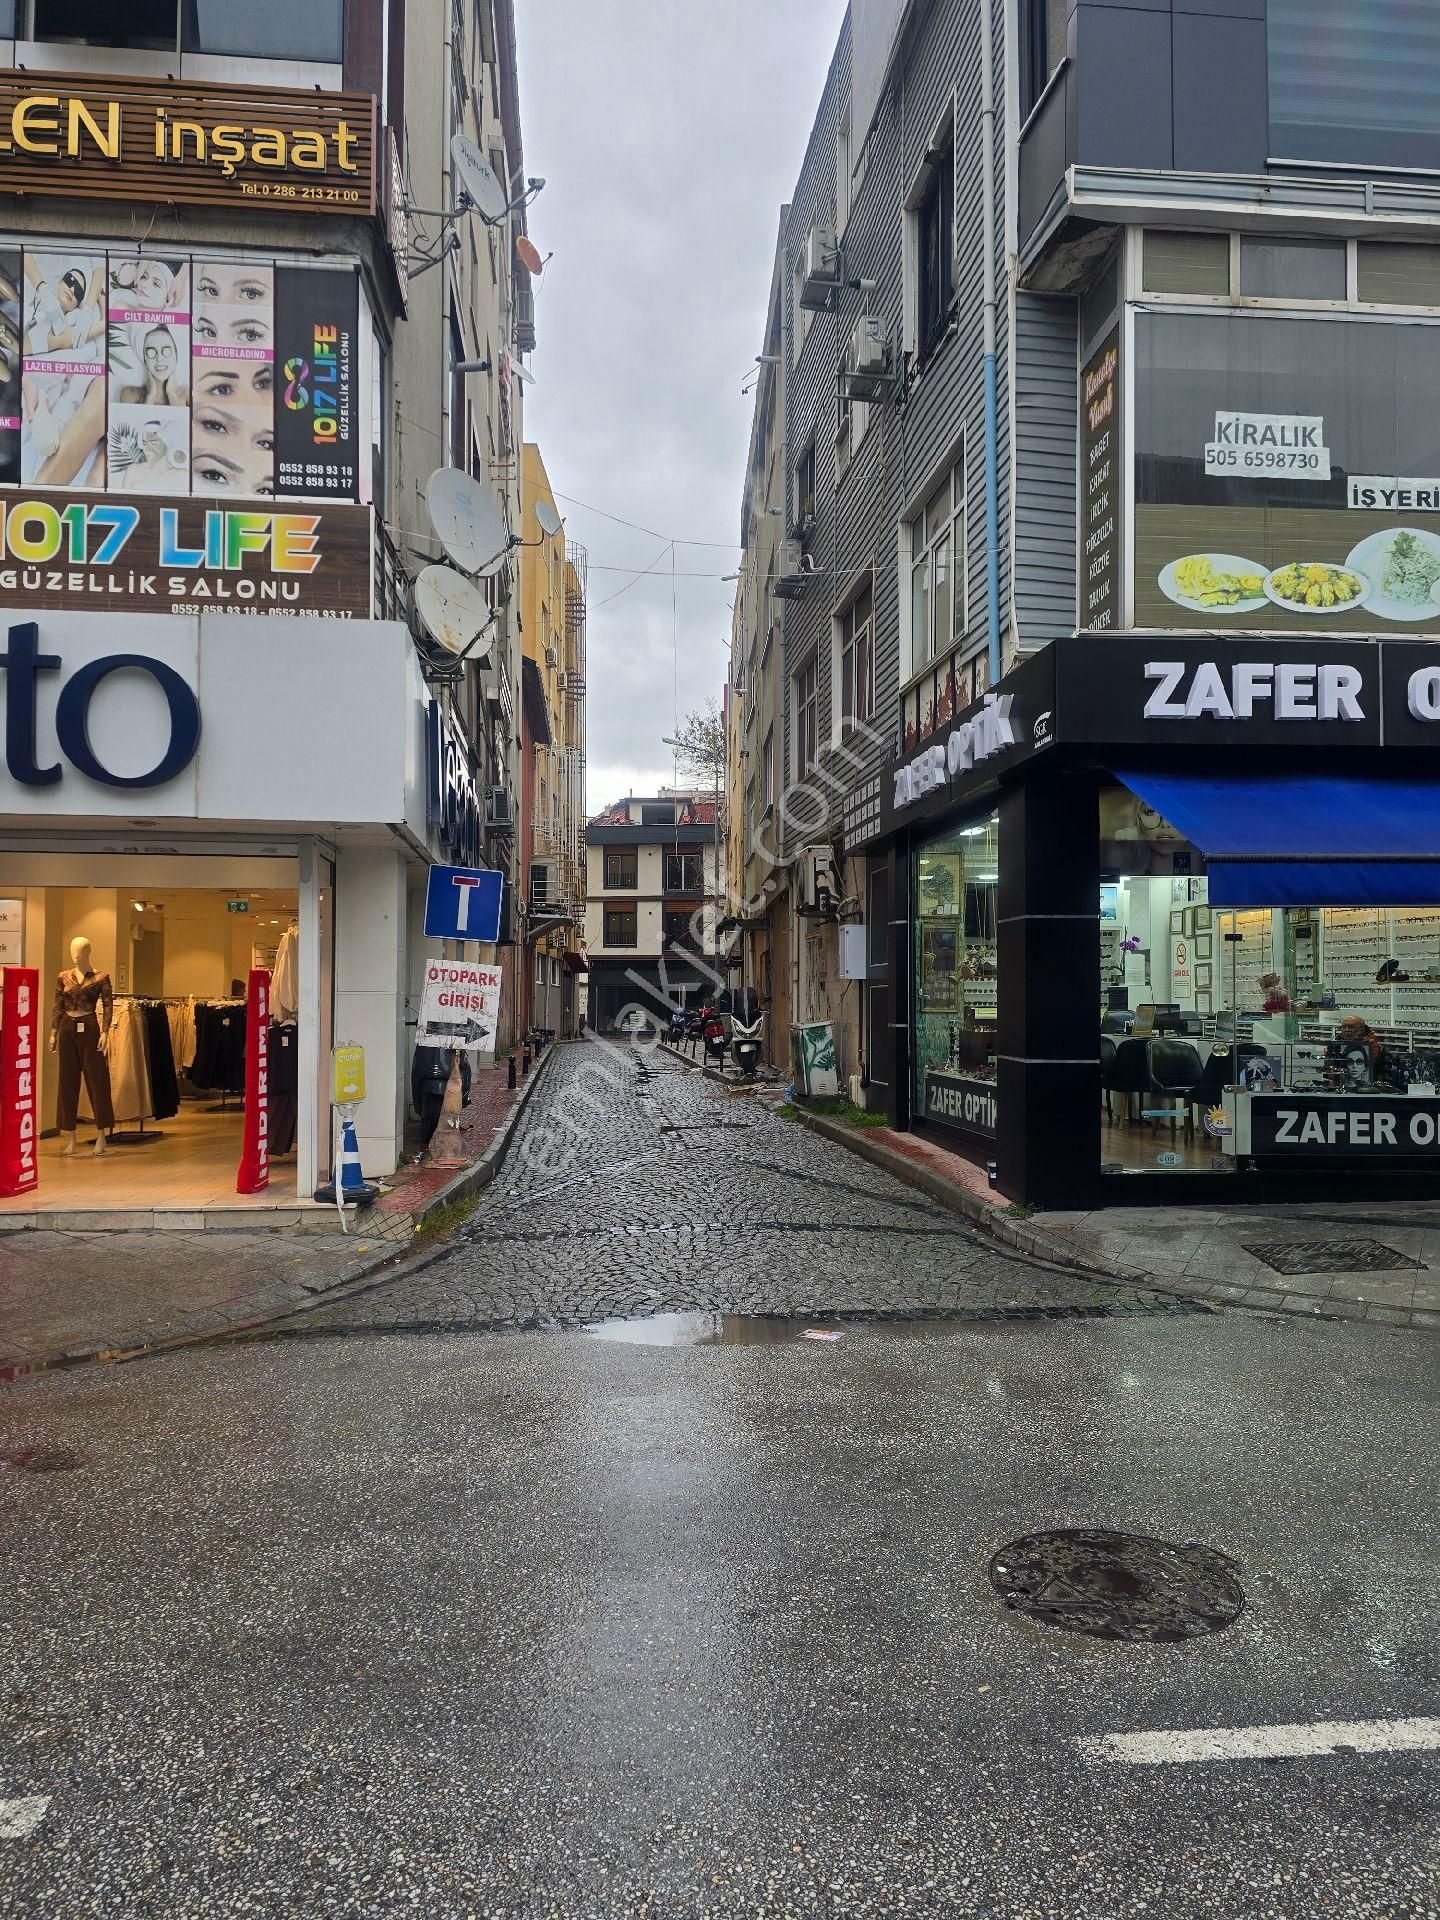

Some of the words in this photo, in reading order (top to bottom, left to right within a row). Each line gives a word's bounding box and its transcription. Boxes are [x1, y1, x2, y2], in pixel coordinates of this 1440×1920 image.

[0, 96, 121, 161] EN
[155, 107, 358, 177] inşaat
[273, 184, 296, 198] 286
[301, 187, 323, 199] 213
[326, 188, 340, 201] 21
[343, 189, 359, 202] 00
[144, 312, 175, 325] BAKIMI
[25, 361, 52, 373] LAZER
[55, 361, 102, 375] EPİLASYON
[314, 324, 337, 383] LIFE
[340, 332, 350, 381] SALONU
[314, 389, 337, 445] 1017
[340, 383, 350, 440] GÜZELLİK
[1089, 430, 1110, 467] BAGET
[1216, 417, 1319, 448] KİRALIK
[279, 463, 303, 474] 0552
[305, 464, 324, 475] 858
[326, 465, 339, 476] 93
[341, 466, 353, 476] 18
[1205, 449, 1238, 466] 505
[1245, 451, 1319, 469] 6598730
[279, 475, 303, 485] 0552
[305, 476, 324, 486] 858
[326, 477, 339, 487] 93
[341, 478, 353, 488] 17
[1353, 484, 1440, 508] İŞYERİ
[0, 501, 140, 566] 017
[159, 507, 323, 575] LIFE
[0, 566, 157, 596] GÜZELLİK
[168, 576, 301, 601] SALONU
[171, 603, 200, 615] 0552
[203, 604, 224, 615] 858
[227, 605, 241, 616] 93
[244, 606, 257, 616] 18
[268, 608, 296, 617] 0552
[299, 608, 319, 618] 858
[1143, 661, 1366, 722] ZAFER
[893, 745, 946, 810] ZAFER
[948, 693, 1015, 776] OPTİK
[428, 967, 498, 987] OTOPARK
[438, 990, 484, 1013] GİRİŞİ
[15, 1025, 35, 1184] İNDİRİM
[930, 1085, 962, 1119] ZAFER
[1275, 1110, 1398, 1145] ZAFER
[1409, 1112, 1440, 1146] O
